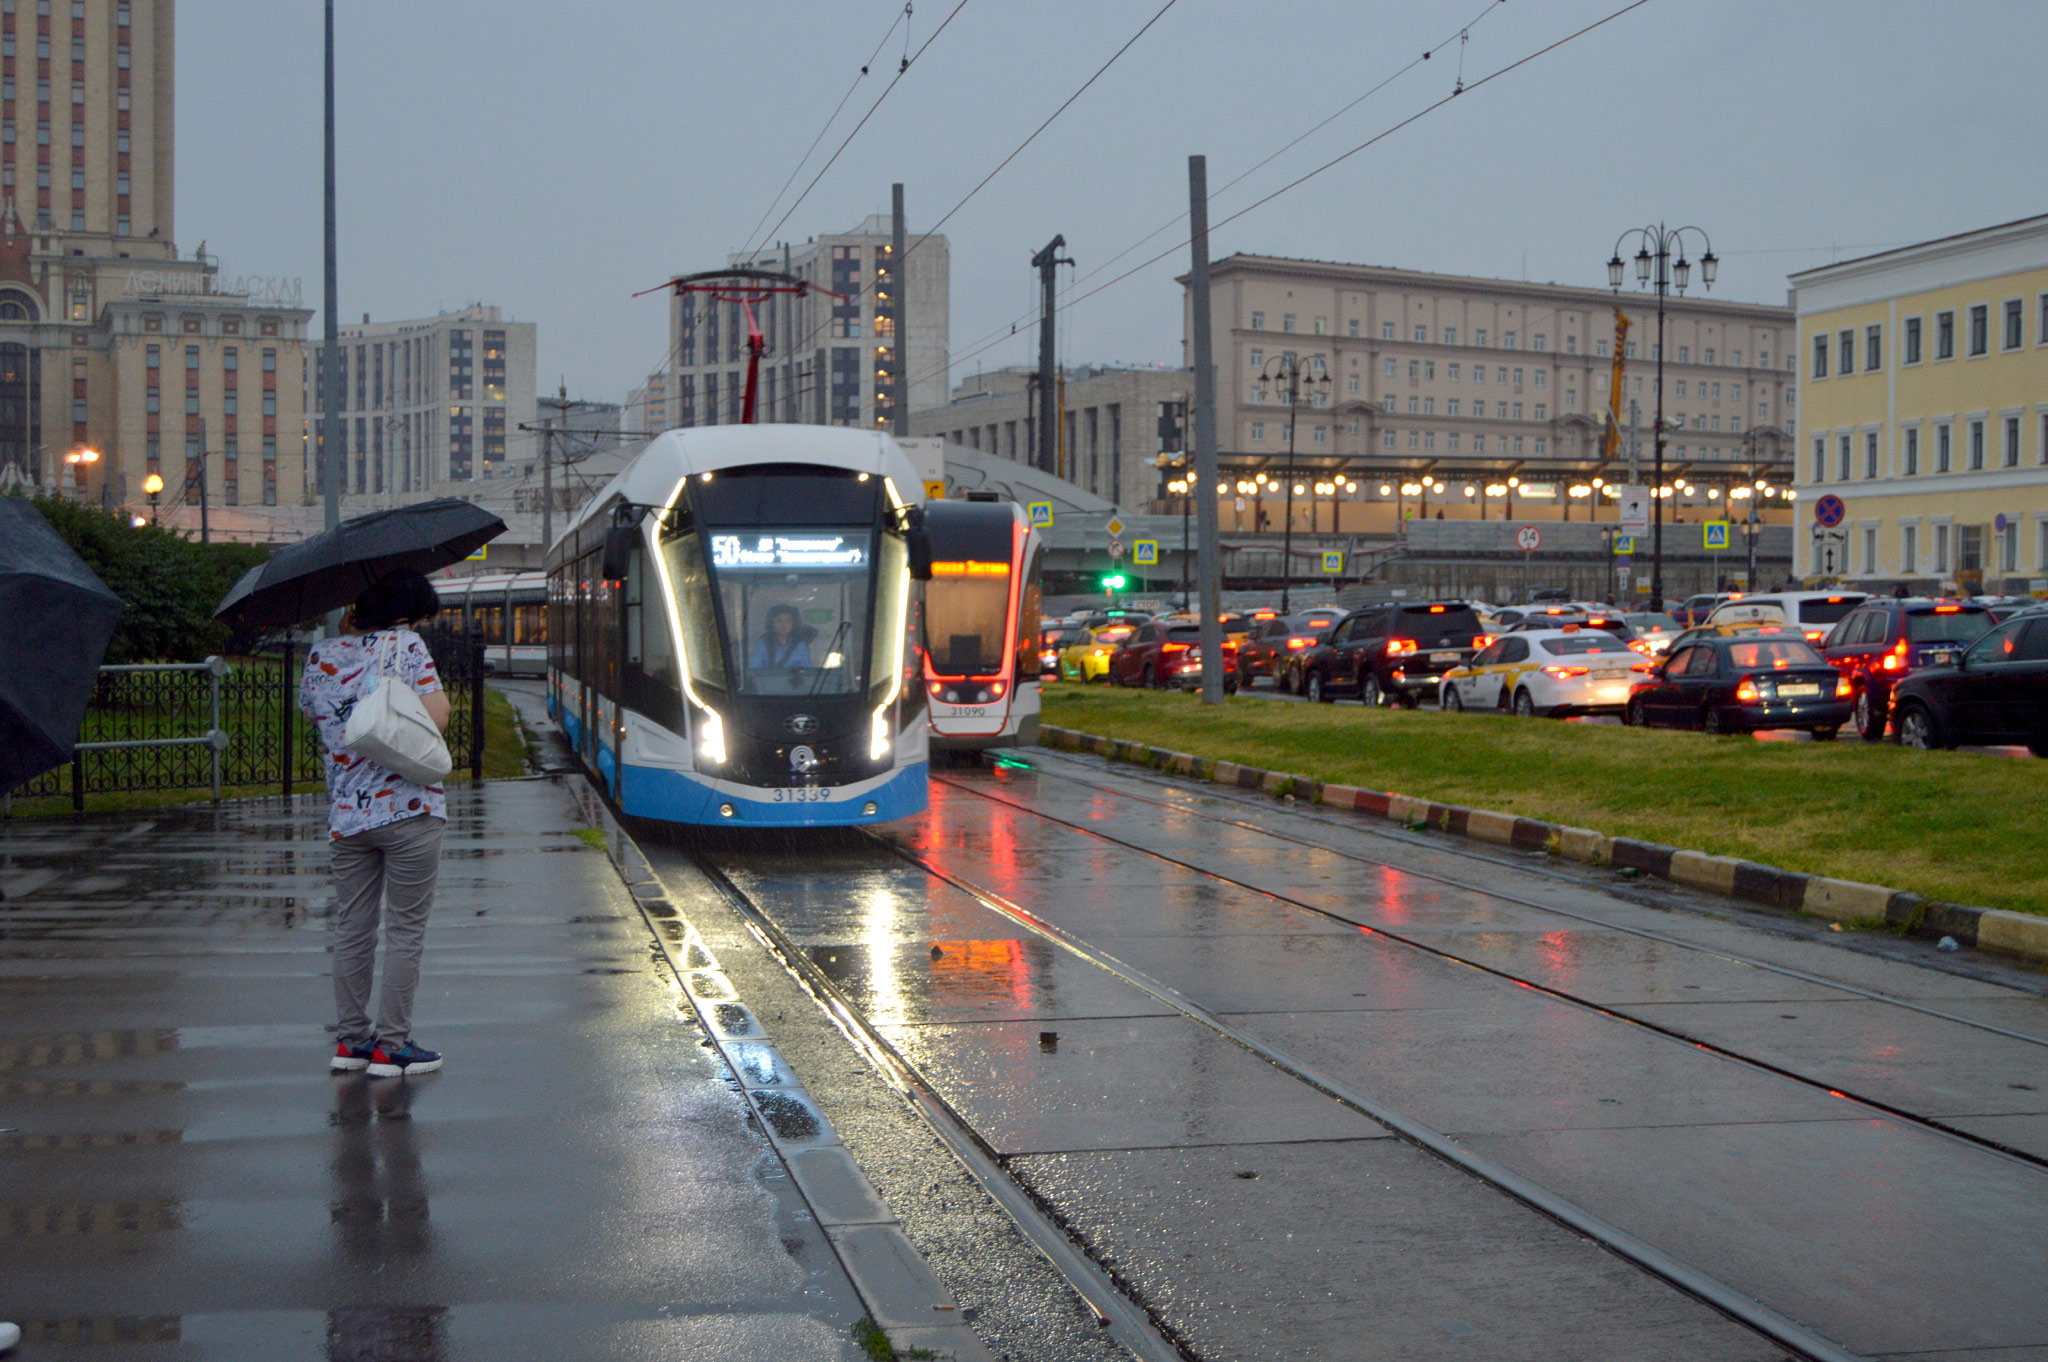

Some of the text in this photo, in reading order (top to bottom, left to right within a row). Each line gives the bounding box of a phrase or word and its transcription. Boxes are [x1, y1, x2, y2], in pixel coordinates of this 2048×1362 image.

[714, 537, 739, 564] 50
[951, 706, 986, 717] 31090
[773, 788, 831, 802] 31339
